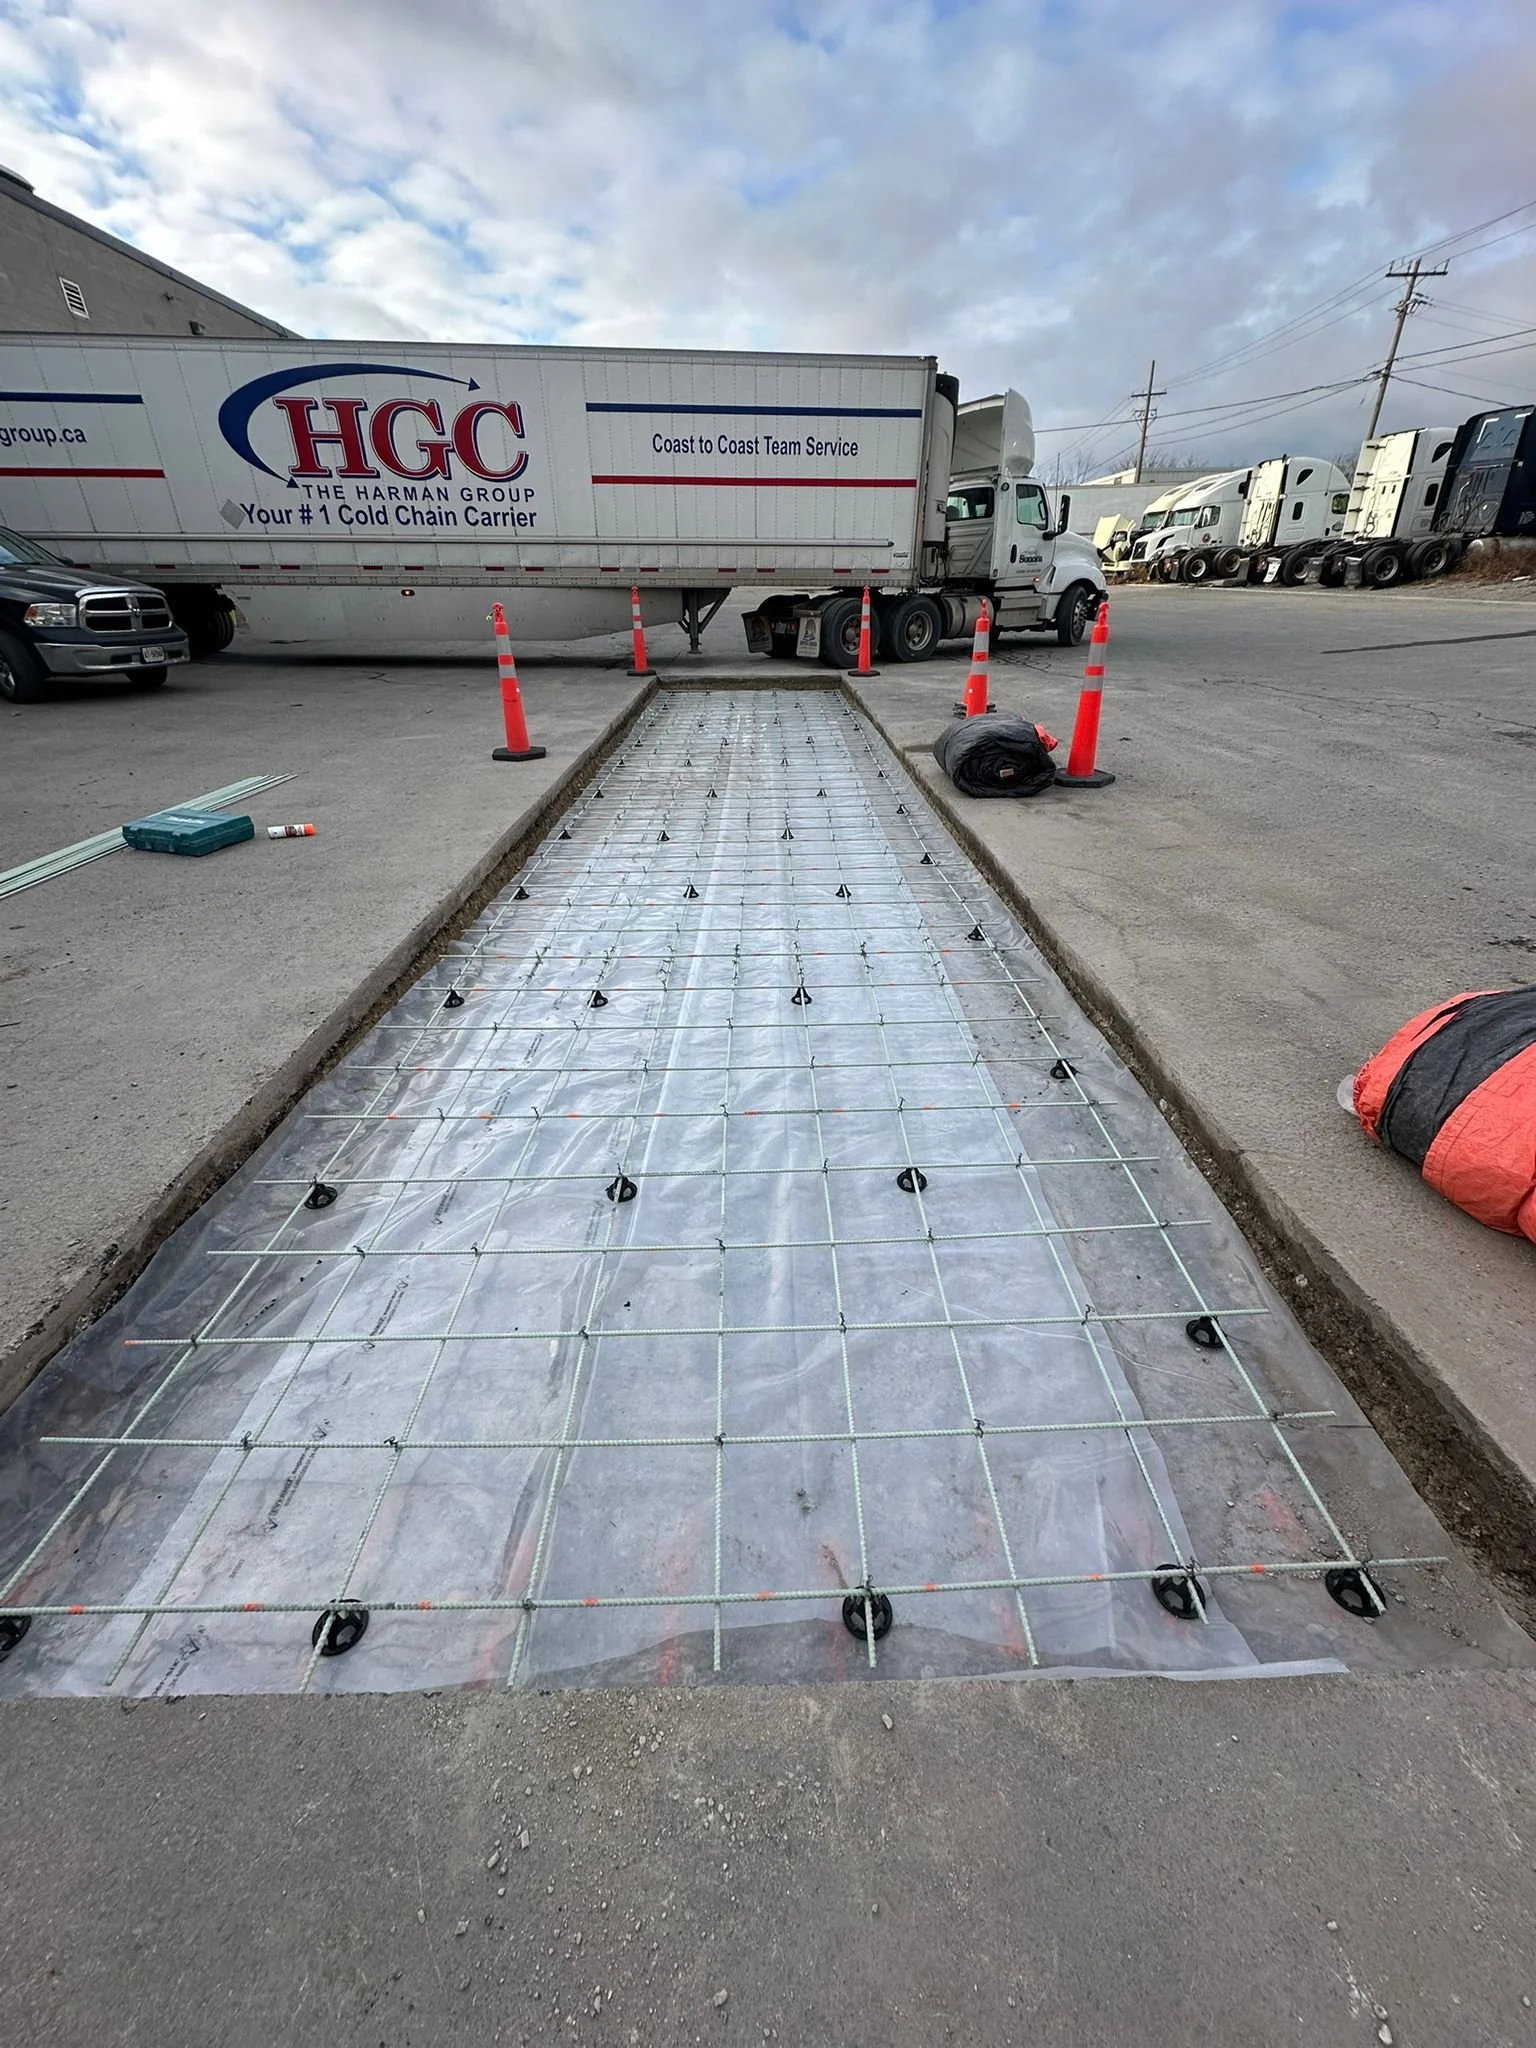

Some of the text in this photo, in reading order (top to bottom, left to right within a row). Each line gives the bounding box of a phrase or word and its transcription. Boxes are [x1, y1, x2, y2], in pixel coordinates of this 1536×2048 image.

[0, 427, 88, 447] group.ca
[273, 397, 529, 482] HGC
[652, 433, 859, 456] Coast to Coast Team Service
[302, 484, 535, 503] THE HARMAN GROUP
[240, 503, 537, 527] Your # 1 Cold Chain Carrier
